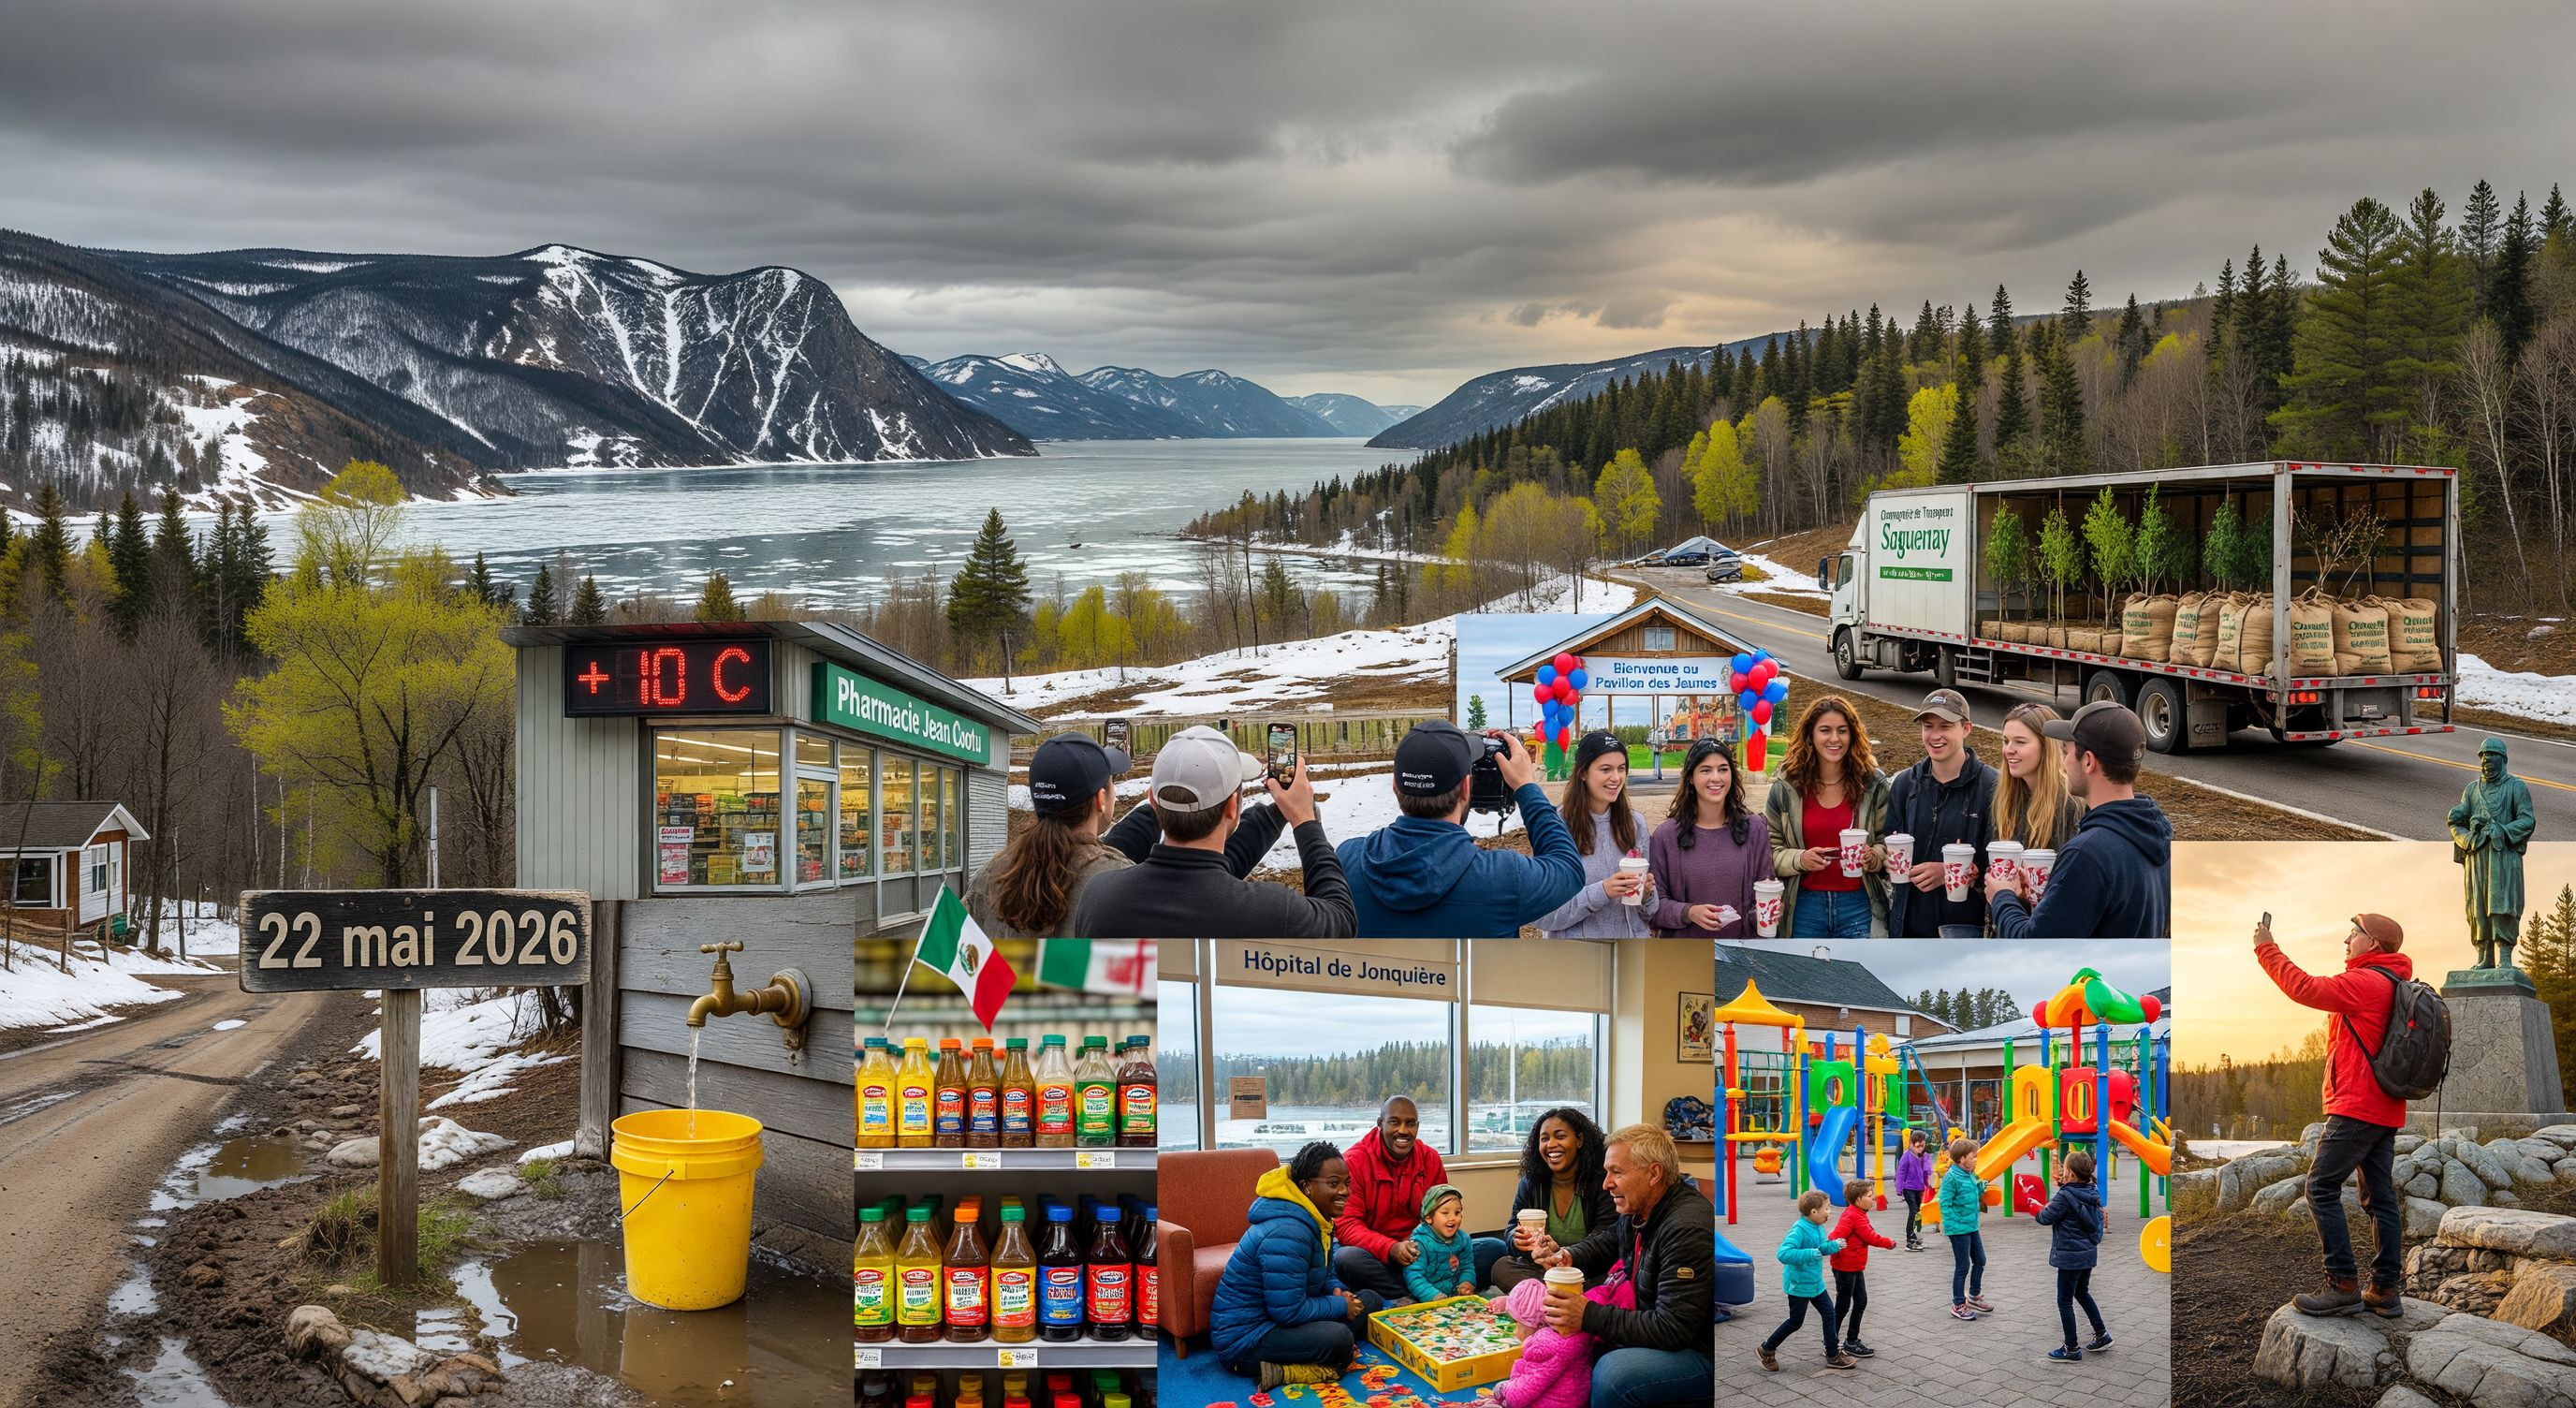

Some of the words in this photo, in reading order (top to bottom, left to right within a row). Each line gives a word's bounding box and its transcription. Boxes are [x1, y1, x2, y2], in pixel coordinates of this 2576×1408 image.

[1881, 522, 1951, 559] Saguenay
[640, 647, 686, 706] 10
[712, 647, 751, 703] C
[1595, 677, 1644, 689] Pavillon
[1648, 677, 1671, 689] des
[1675, 677, 1717, 689] Jeunes
[837, 676, 920, 736] Pharmacie
[922, 710, 951, 745] Jean
[258, 911, 322, 969] 22
[343, 910, 434, 968] mai
[455, 909, 578, 966] 2026
[1244, 949, 1321, 976] Hôpital
[1327, 958, 1352, 977] de
[1357, 961, 1446, 987] Jonquière
